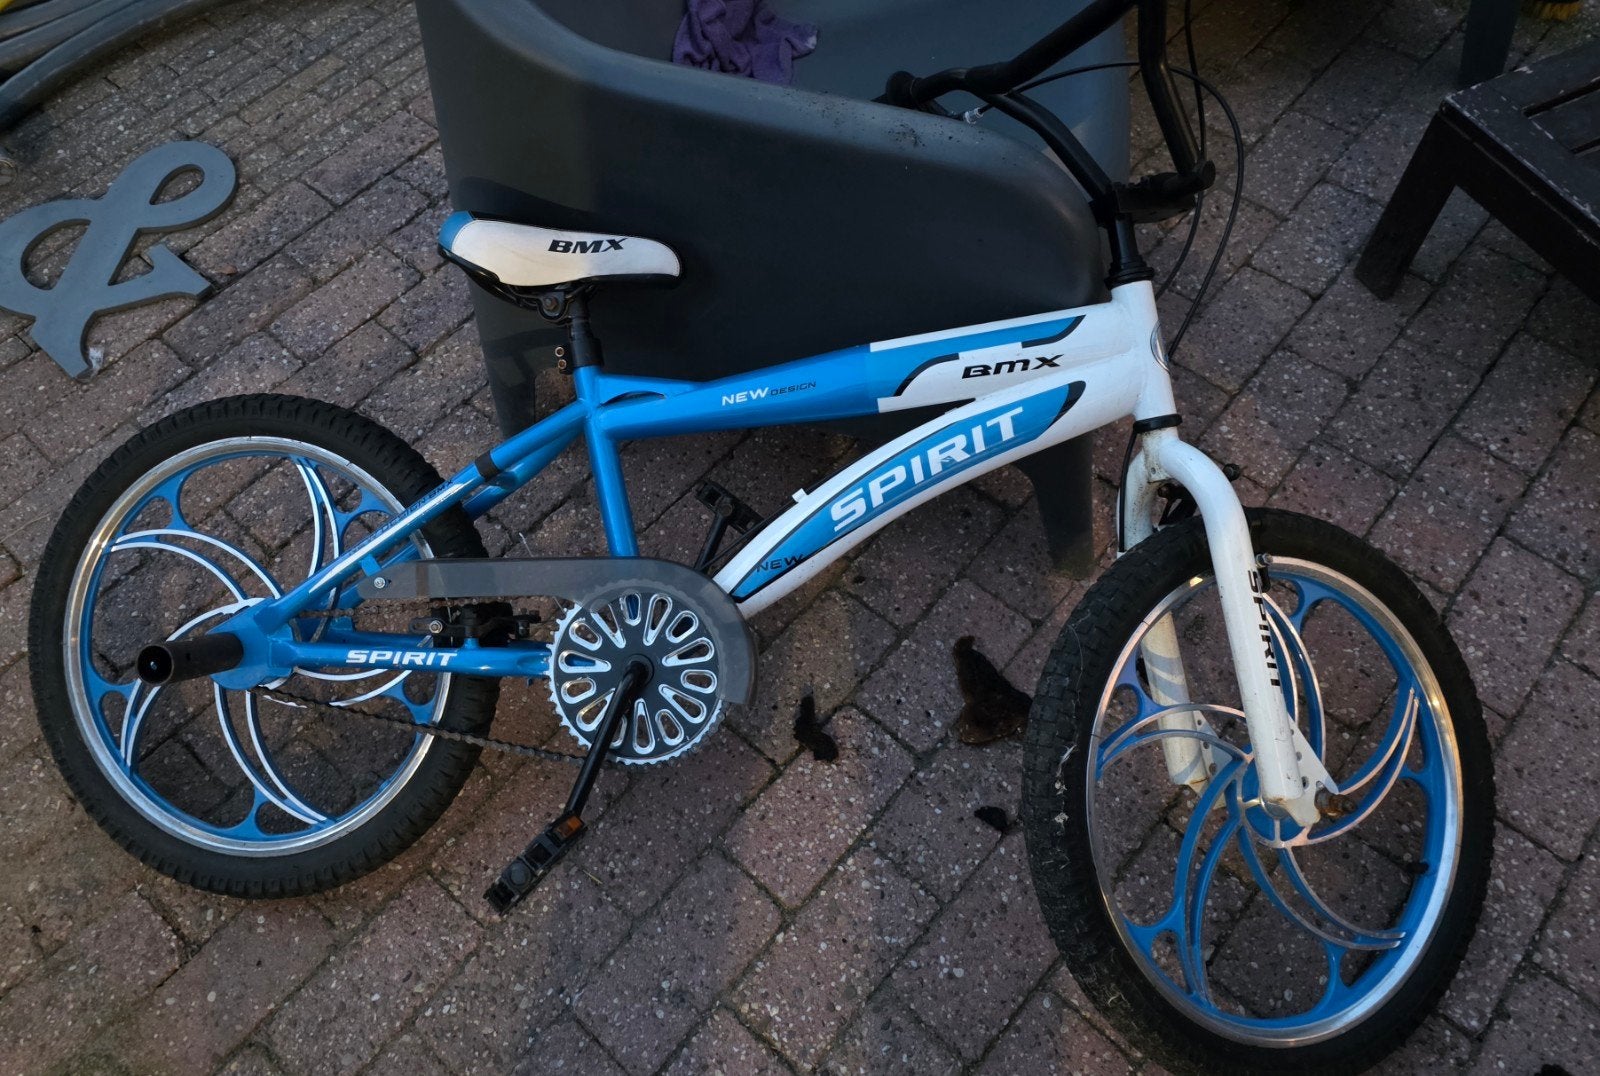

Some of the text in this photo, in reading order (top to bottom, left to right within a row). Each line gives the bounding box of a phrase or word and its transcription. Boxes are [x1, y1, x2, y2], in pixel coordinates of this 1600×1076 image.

[548, 237, 627, 254] BMX
[962, 354, 1064, 379] BMX
[722, 381, 817, 406] NEW DESIGN
[830, 406, 1024, 532] SPIRIT
[756, 553, 804, 573] NEW
[345, 649, 458, 667] SPIRIT
